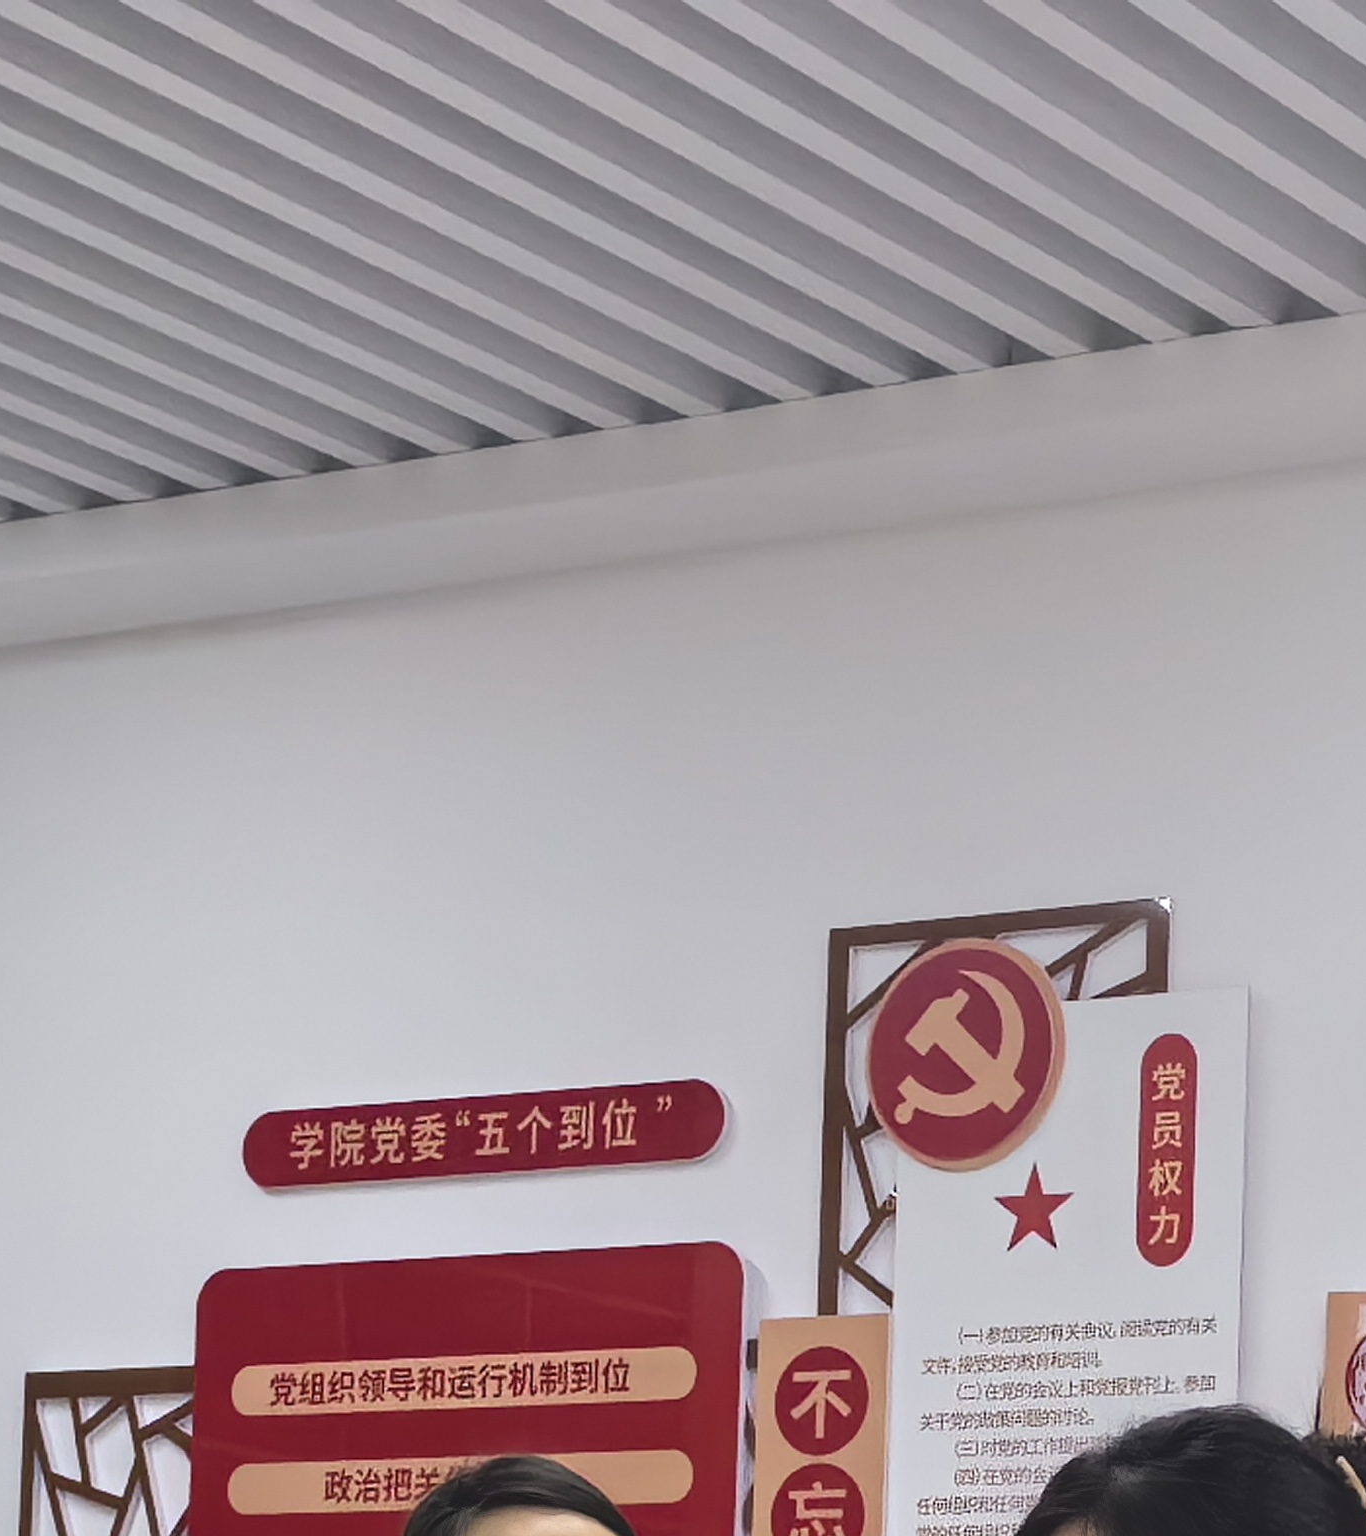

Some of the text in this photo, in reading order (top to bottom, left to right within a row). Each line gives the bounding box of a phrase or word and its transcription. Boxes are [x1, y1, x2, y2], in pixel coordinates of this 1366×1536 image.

[289, 1094, 672, 1171] 学院党委“五个到位”
[1148, 1062, 1186, 1246] 党员权力
[268, 1358, 631, 1406] 党组织领导和运行机制到位
[323, 1467, 470, 1503] 政治把关
